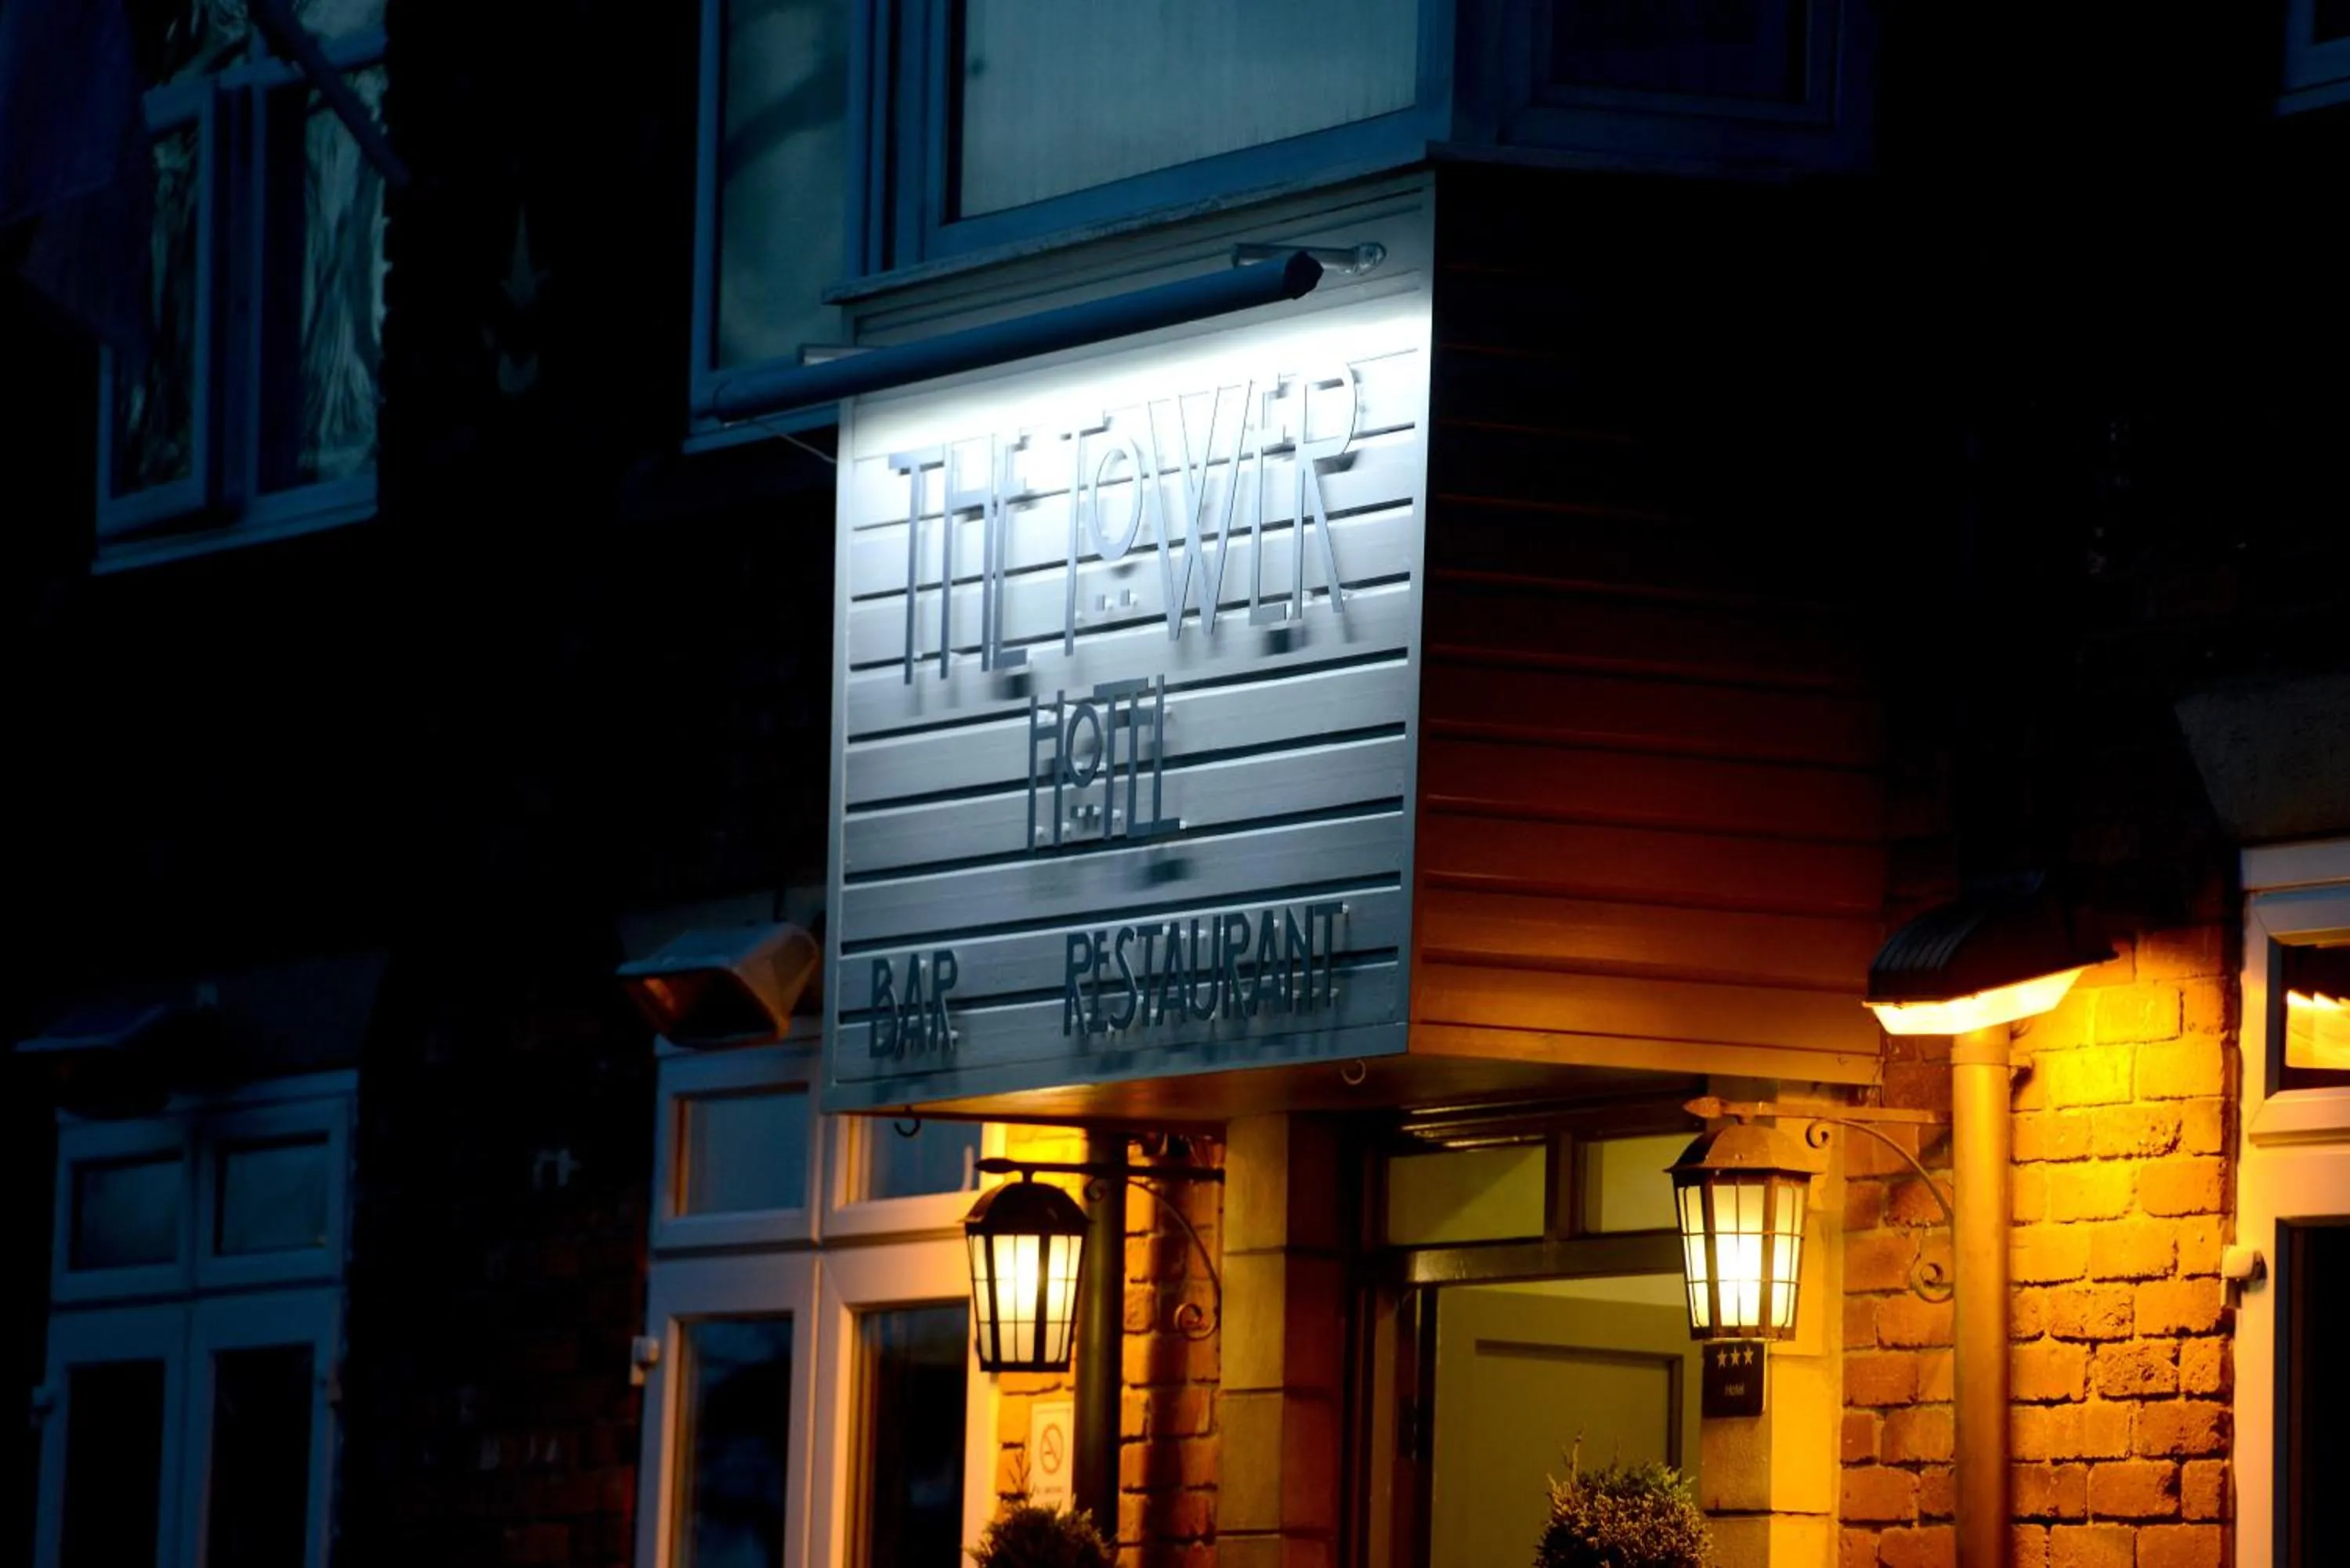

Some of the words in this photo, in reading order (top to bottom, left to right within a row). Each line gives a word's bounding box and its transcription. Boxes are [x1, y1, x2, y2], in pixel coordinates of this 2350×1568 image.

[888, 427, 1029, 685] THE
[1061, 361, 1359, 656] TOWER
[1028, 674, 1180, 852] HOTEL
[870, 949, 958, 1059] BAR
[1063, 901, 1343, 1036] RESTAURANT
